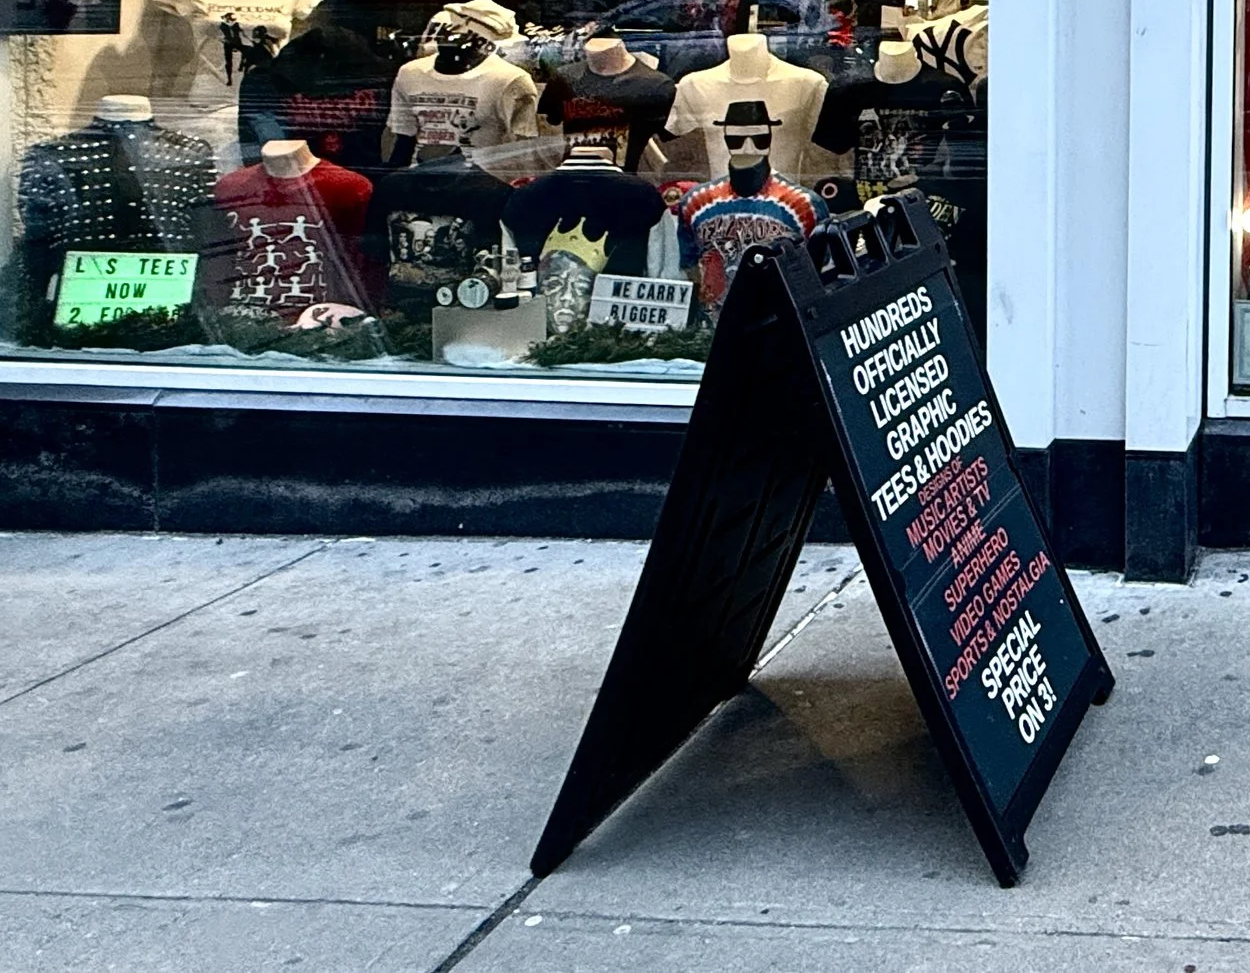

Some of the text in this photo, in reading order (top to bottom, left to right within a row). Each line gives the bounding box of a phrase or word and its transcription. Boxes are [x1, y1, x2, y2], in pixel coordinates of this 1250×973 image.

[105, 283, 147, 299] NOW
[139, 258, 189, 275] TEES
[611, 281, 688, 303] WE CARRY
[68, 307, 81, 324] 2
[610, 304, 667, 324] BIGGER
[840, 286, 932, 358] HUNDREDS
[853, 317, 941, 395] OFFICIALLY
[870, 354, 949, 429] LICENSED
[871, 400, 992, 521] TEES & HOODIES
[887, 388, 956, 460] GRAPHIC
[906, 456, 988, 548] MUSIC ARTISTS
[918, 455, 963, 506] DESIGNS OF
[923, 480, 991, 563] MOVIES & TV
[951, 519, 987, 569] ANIME
[944, 527, 1008, 612] SUPERHERO
[950, 550, 1020, 646] VIDEO GAMES
[945, 551, 1050, 700] SPORTS & NOSTALGIA
[981, 610, 1041, 700] SPECIAL
[1001, 643, 1046, 720] PRICE
[1018, 676, 1057, 744] ON 3!
